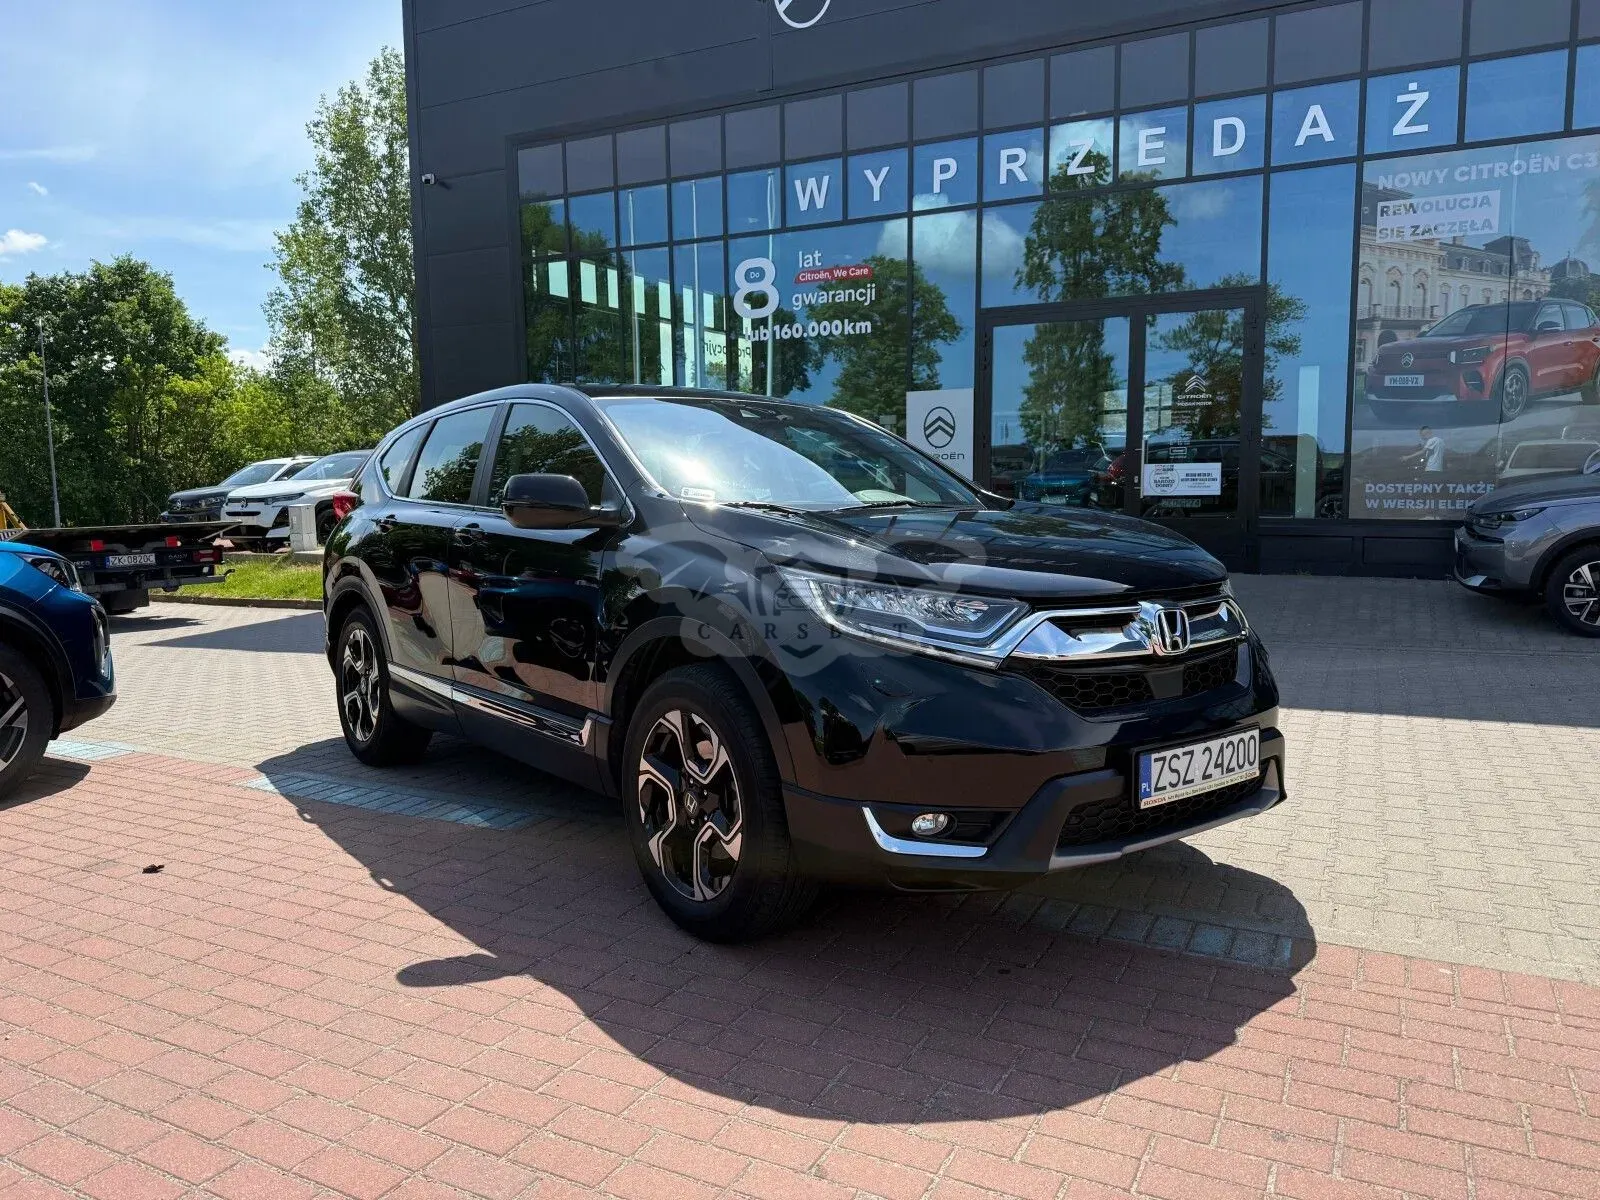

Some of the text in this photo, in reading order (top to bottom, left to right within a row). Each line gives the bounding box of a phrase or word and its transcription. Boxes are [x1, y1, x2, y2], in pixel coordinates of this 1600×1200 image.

[794, 82, 1429, 212] WYPRZEDAŻ
[1378, 151, 1598, 190] NOWY CITROËN C3
[1380, 194, 1492, 217] REWOLUCJA
[798, 250, 822, 268] lat
[750, 271, 761, 279] Do
[799, 266, 869, 282] Citroën, We Care
[733, 257, 780, 319] 8
[792, 283, 876, 311] gwarancji
[745, 318, 872, 342] lub 160.000 km
[1365, 483, 1443, 496] DOSTĘPNY
[1365, 499, 1380, 509] W
[1382, 499, 1435, 509] WERSJI
[1153, 749, 1195, 793] ZSZ
[1202, 734, 1257, 781] 24200
[1141, 782, 1151, 792] PL
